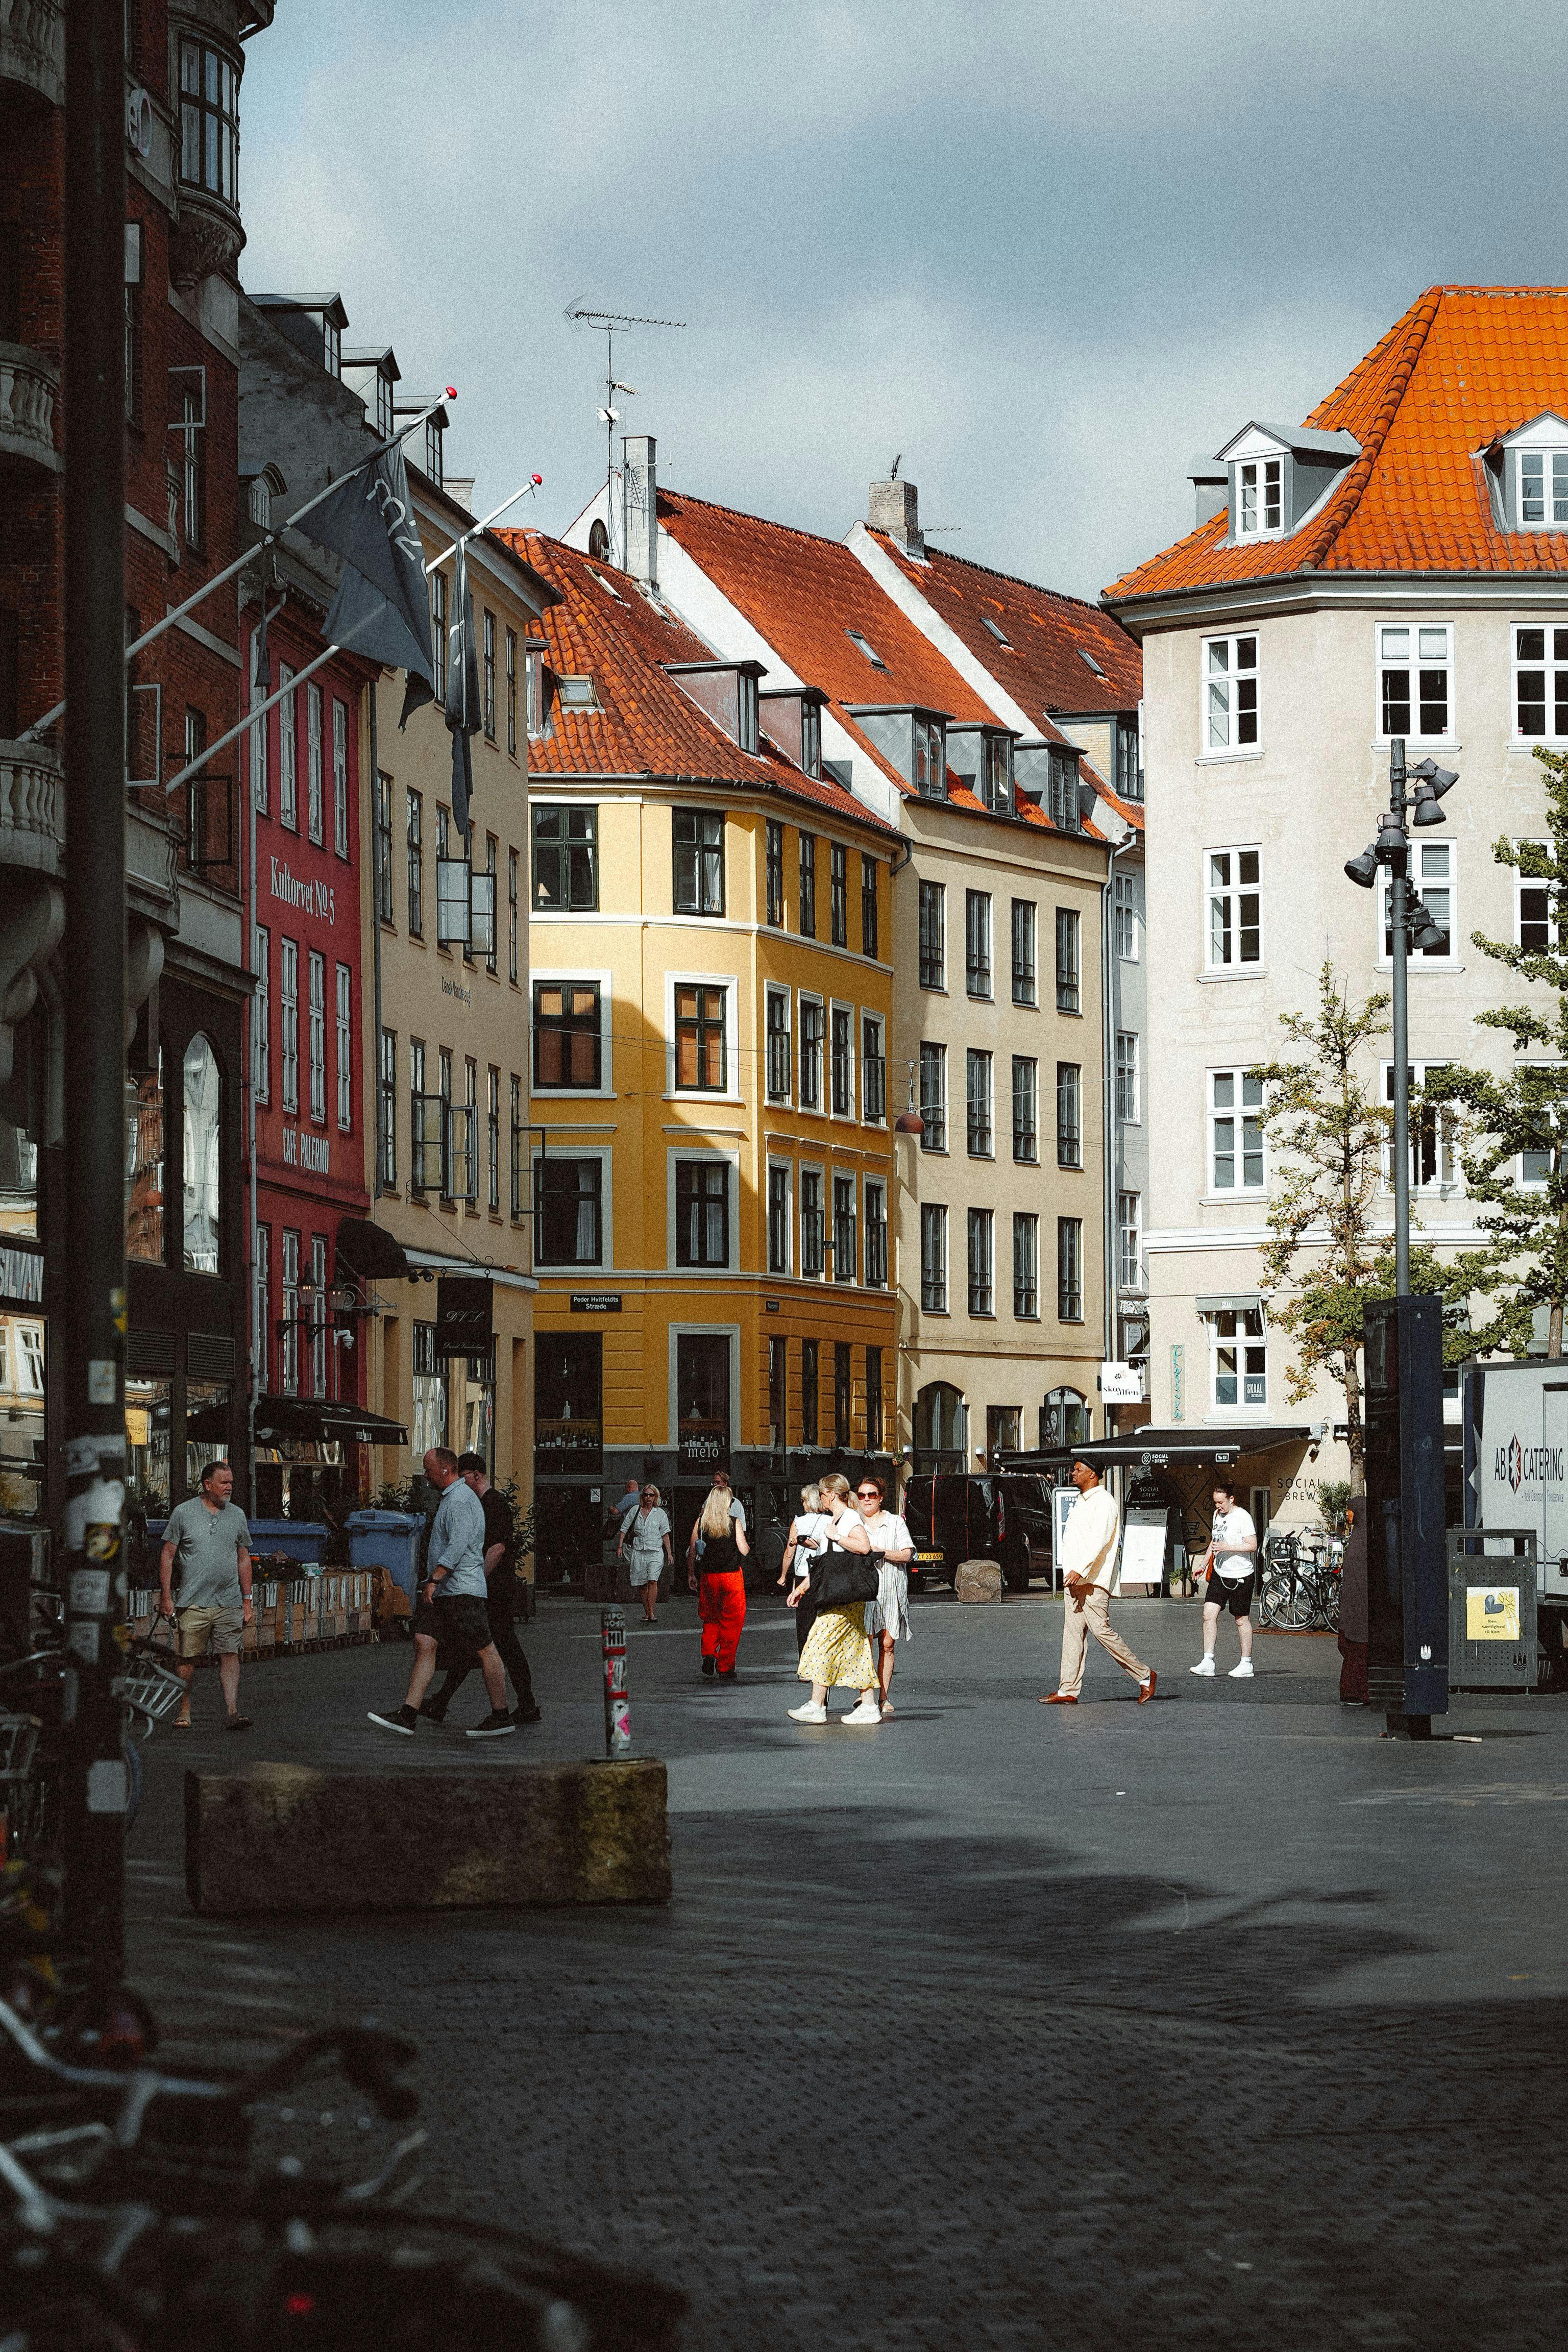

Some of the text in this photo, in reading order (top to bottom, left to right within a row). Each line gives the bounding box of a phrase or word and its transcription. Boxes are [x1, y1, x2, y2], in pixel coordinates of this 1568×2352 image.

[271, 855, 313, 915] Kultorvet
[329, 888, 335, 925] 5
[283, 1121, 329, 1174] CAFÉ PALERMO
[1246, 1383, 1263, 1394] SKAAL
[688, 1445, 719, 1457] melo
[1494, 1448, 1563, 1481] AB CATERING
